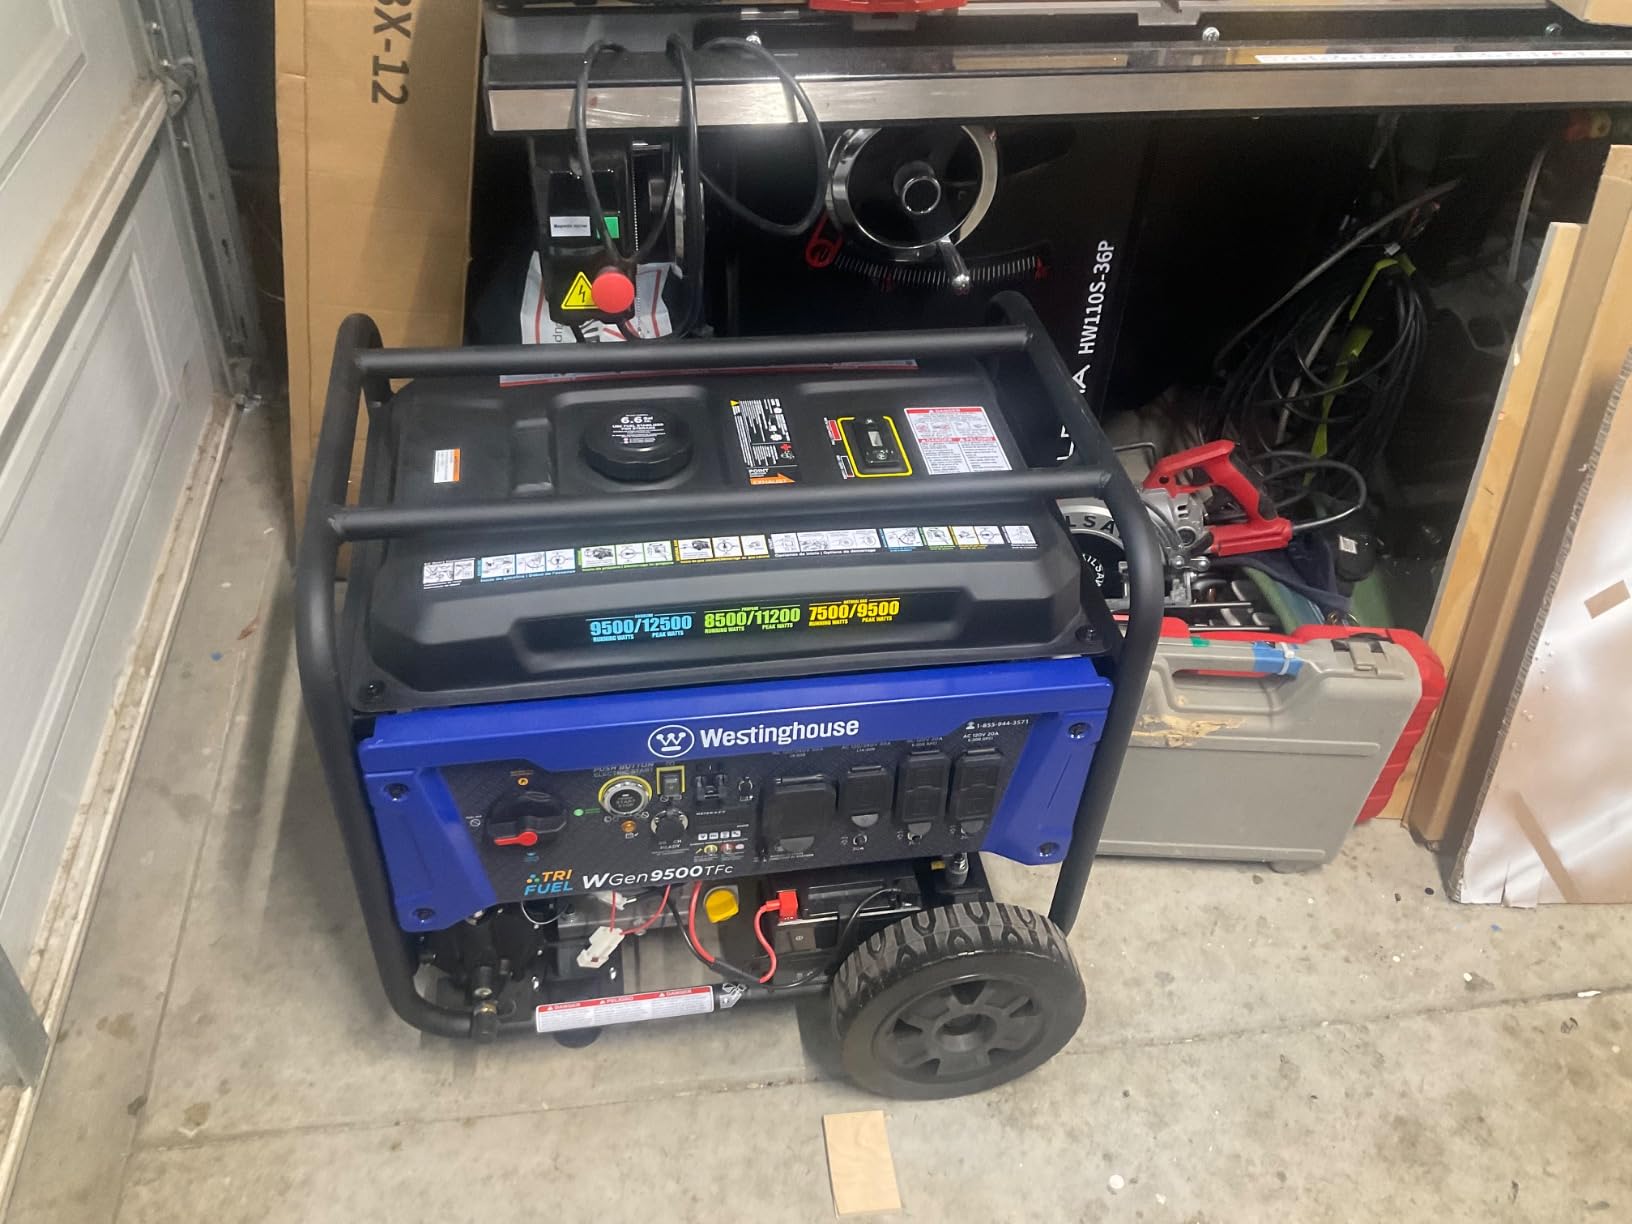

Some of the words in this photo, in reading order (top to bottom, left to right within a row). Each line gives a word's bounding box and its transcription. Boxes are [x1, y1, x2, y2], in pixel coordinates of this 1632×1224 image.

[371, 0, 412, 104] X-12
[1078, 239, 1115, 355] HW110S-36P
[620, 416, 643, 424] 6.6
[704, 607, 801, 628] 8500/11200
[808, 600, 901, 621] 7500/9500
[589, 614, 693, 636] 9500/12500
[700, 719, 860, 748] Westinghouse
[541, 869, 573, 883] TRI
[524, 881, 574, 896] FUEL
